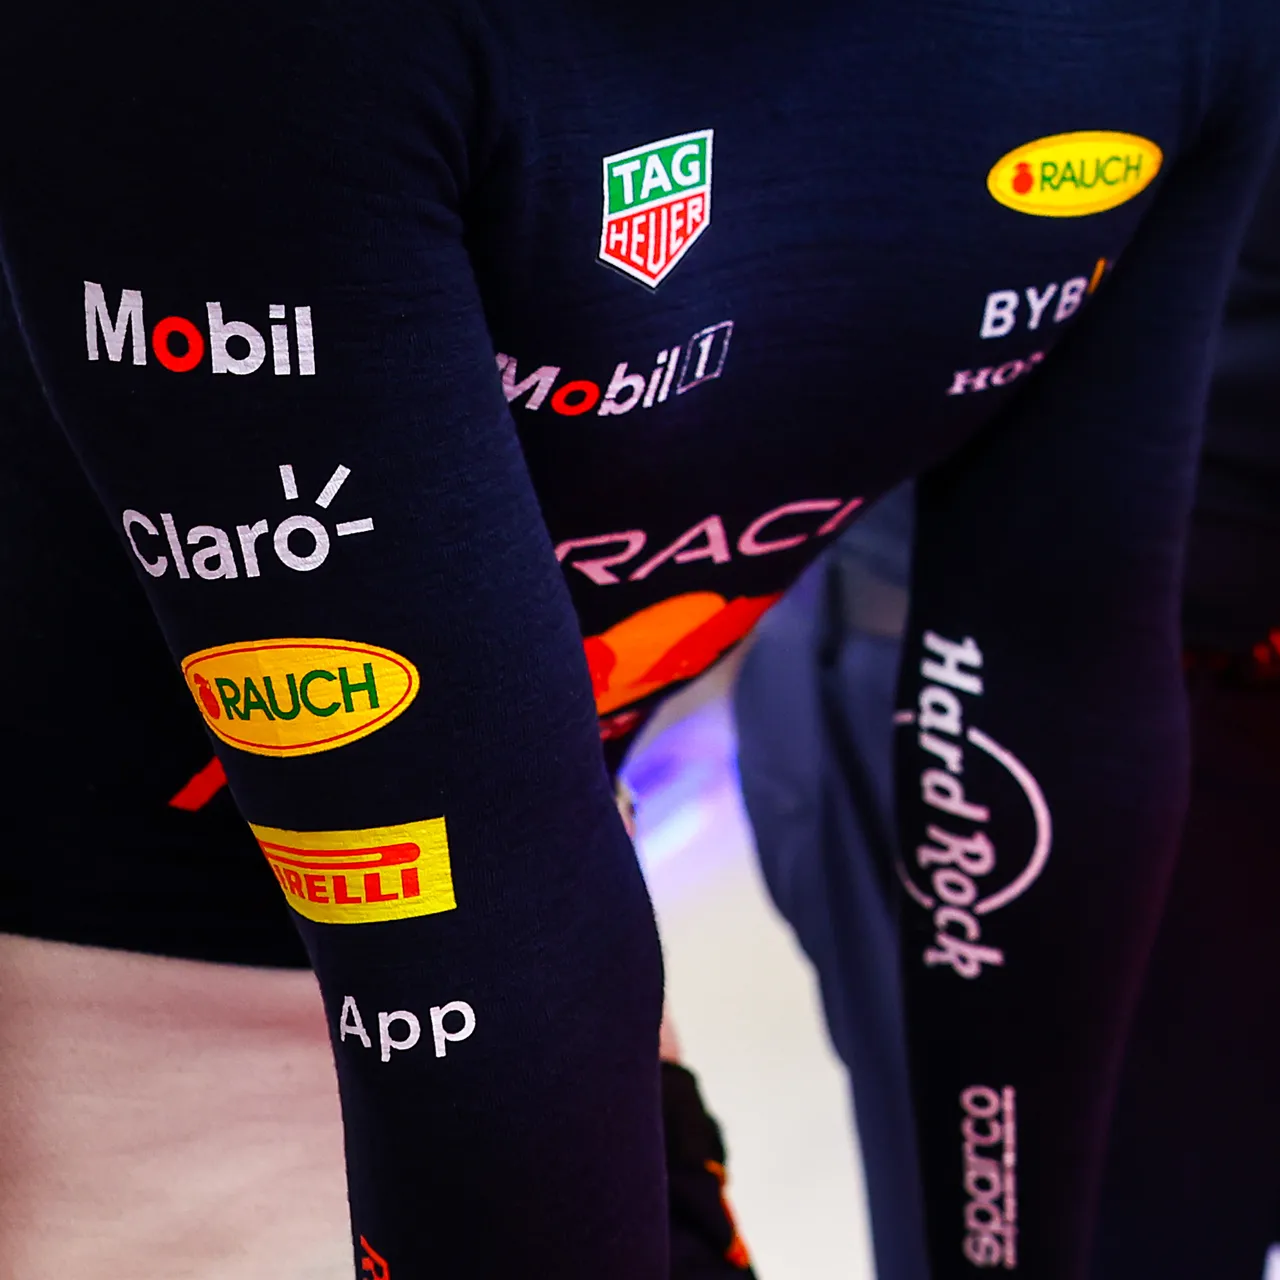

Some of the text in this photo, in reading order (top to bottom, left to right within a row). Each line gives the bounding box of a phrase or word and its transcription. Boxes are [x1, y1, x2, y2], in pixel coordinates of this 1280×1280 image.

[613, 144, 702, 204] TAG
[1039, 154, 1144, 193] RAUCH
[609, 197, 705, 282] HEUER
[84, 280, 316, 376] Mobil
[496, 344, 681, 416] Mobil
[122, 509, 332, 580] Claro
[214, 663, 378, 721] RAUCH
[918, 629, 990, 822] Hard
[917, 824, 1004, 978] Rock
[340, 996, 476, 1062] App
[961, 1086, 1003, 1267] sparco
